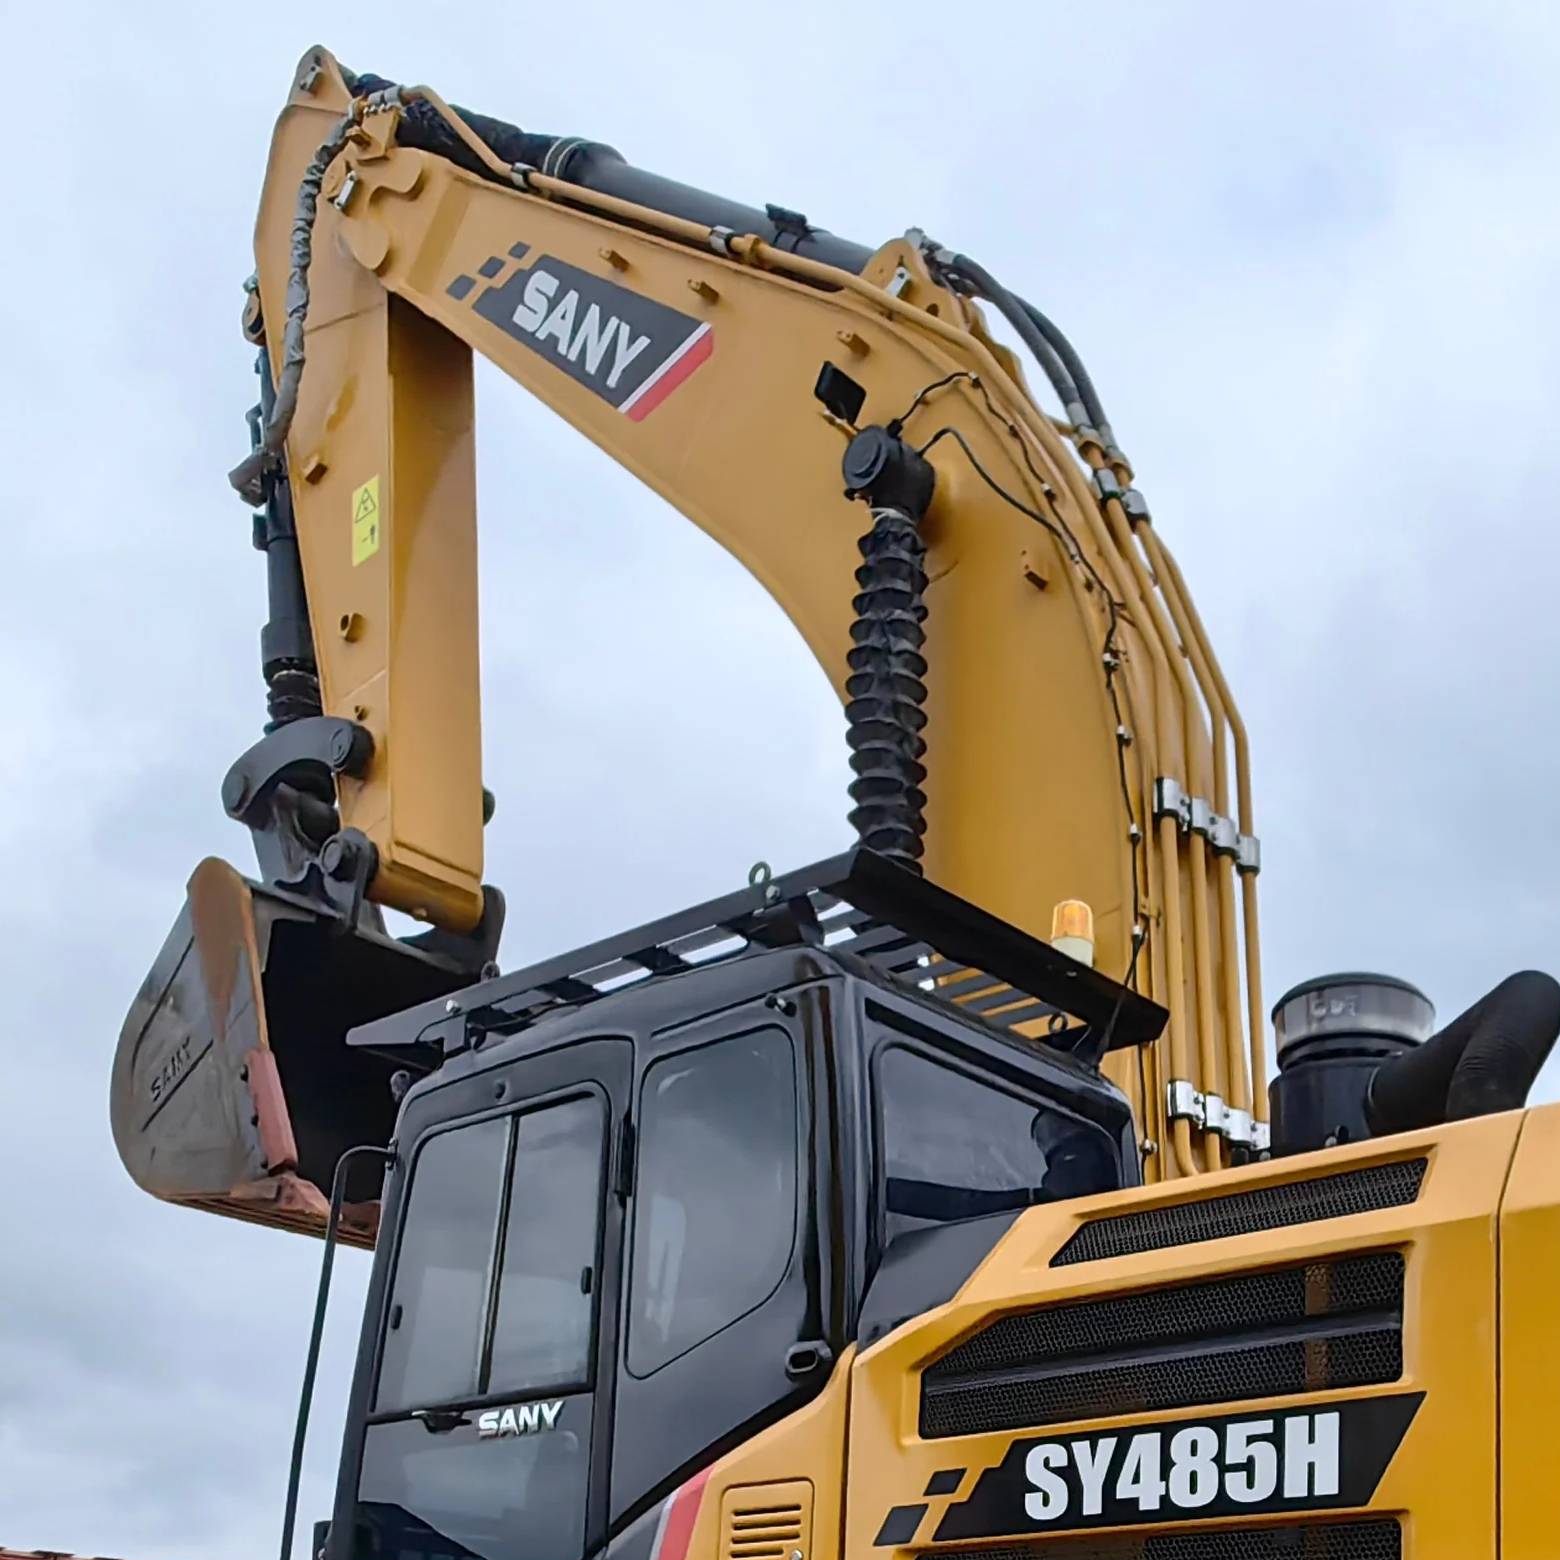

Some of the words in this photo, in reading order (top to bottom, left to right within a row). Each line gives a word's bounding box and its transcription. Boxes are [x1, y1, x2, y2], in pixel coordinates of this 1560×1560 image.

[511, 269, 651, 389] SANY
[478, 1400, 565, 1438] SANY
[1023, 1410, 1341, 1521] SY485H
